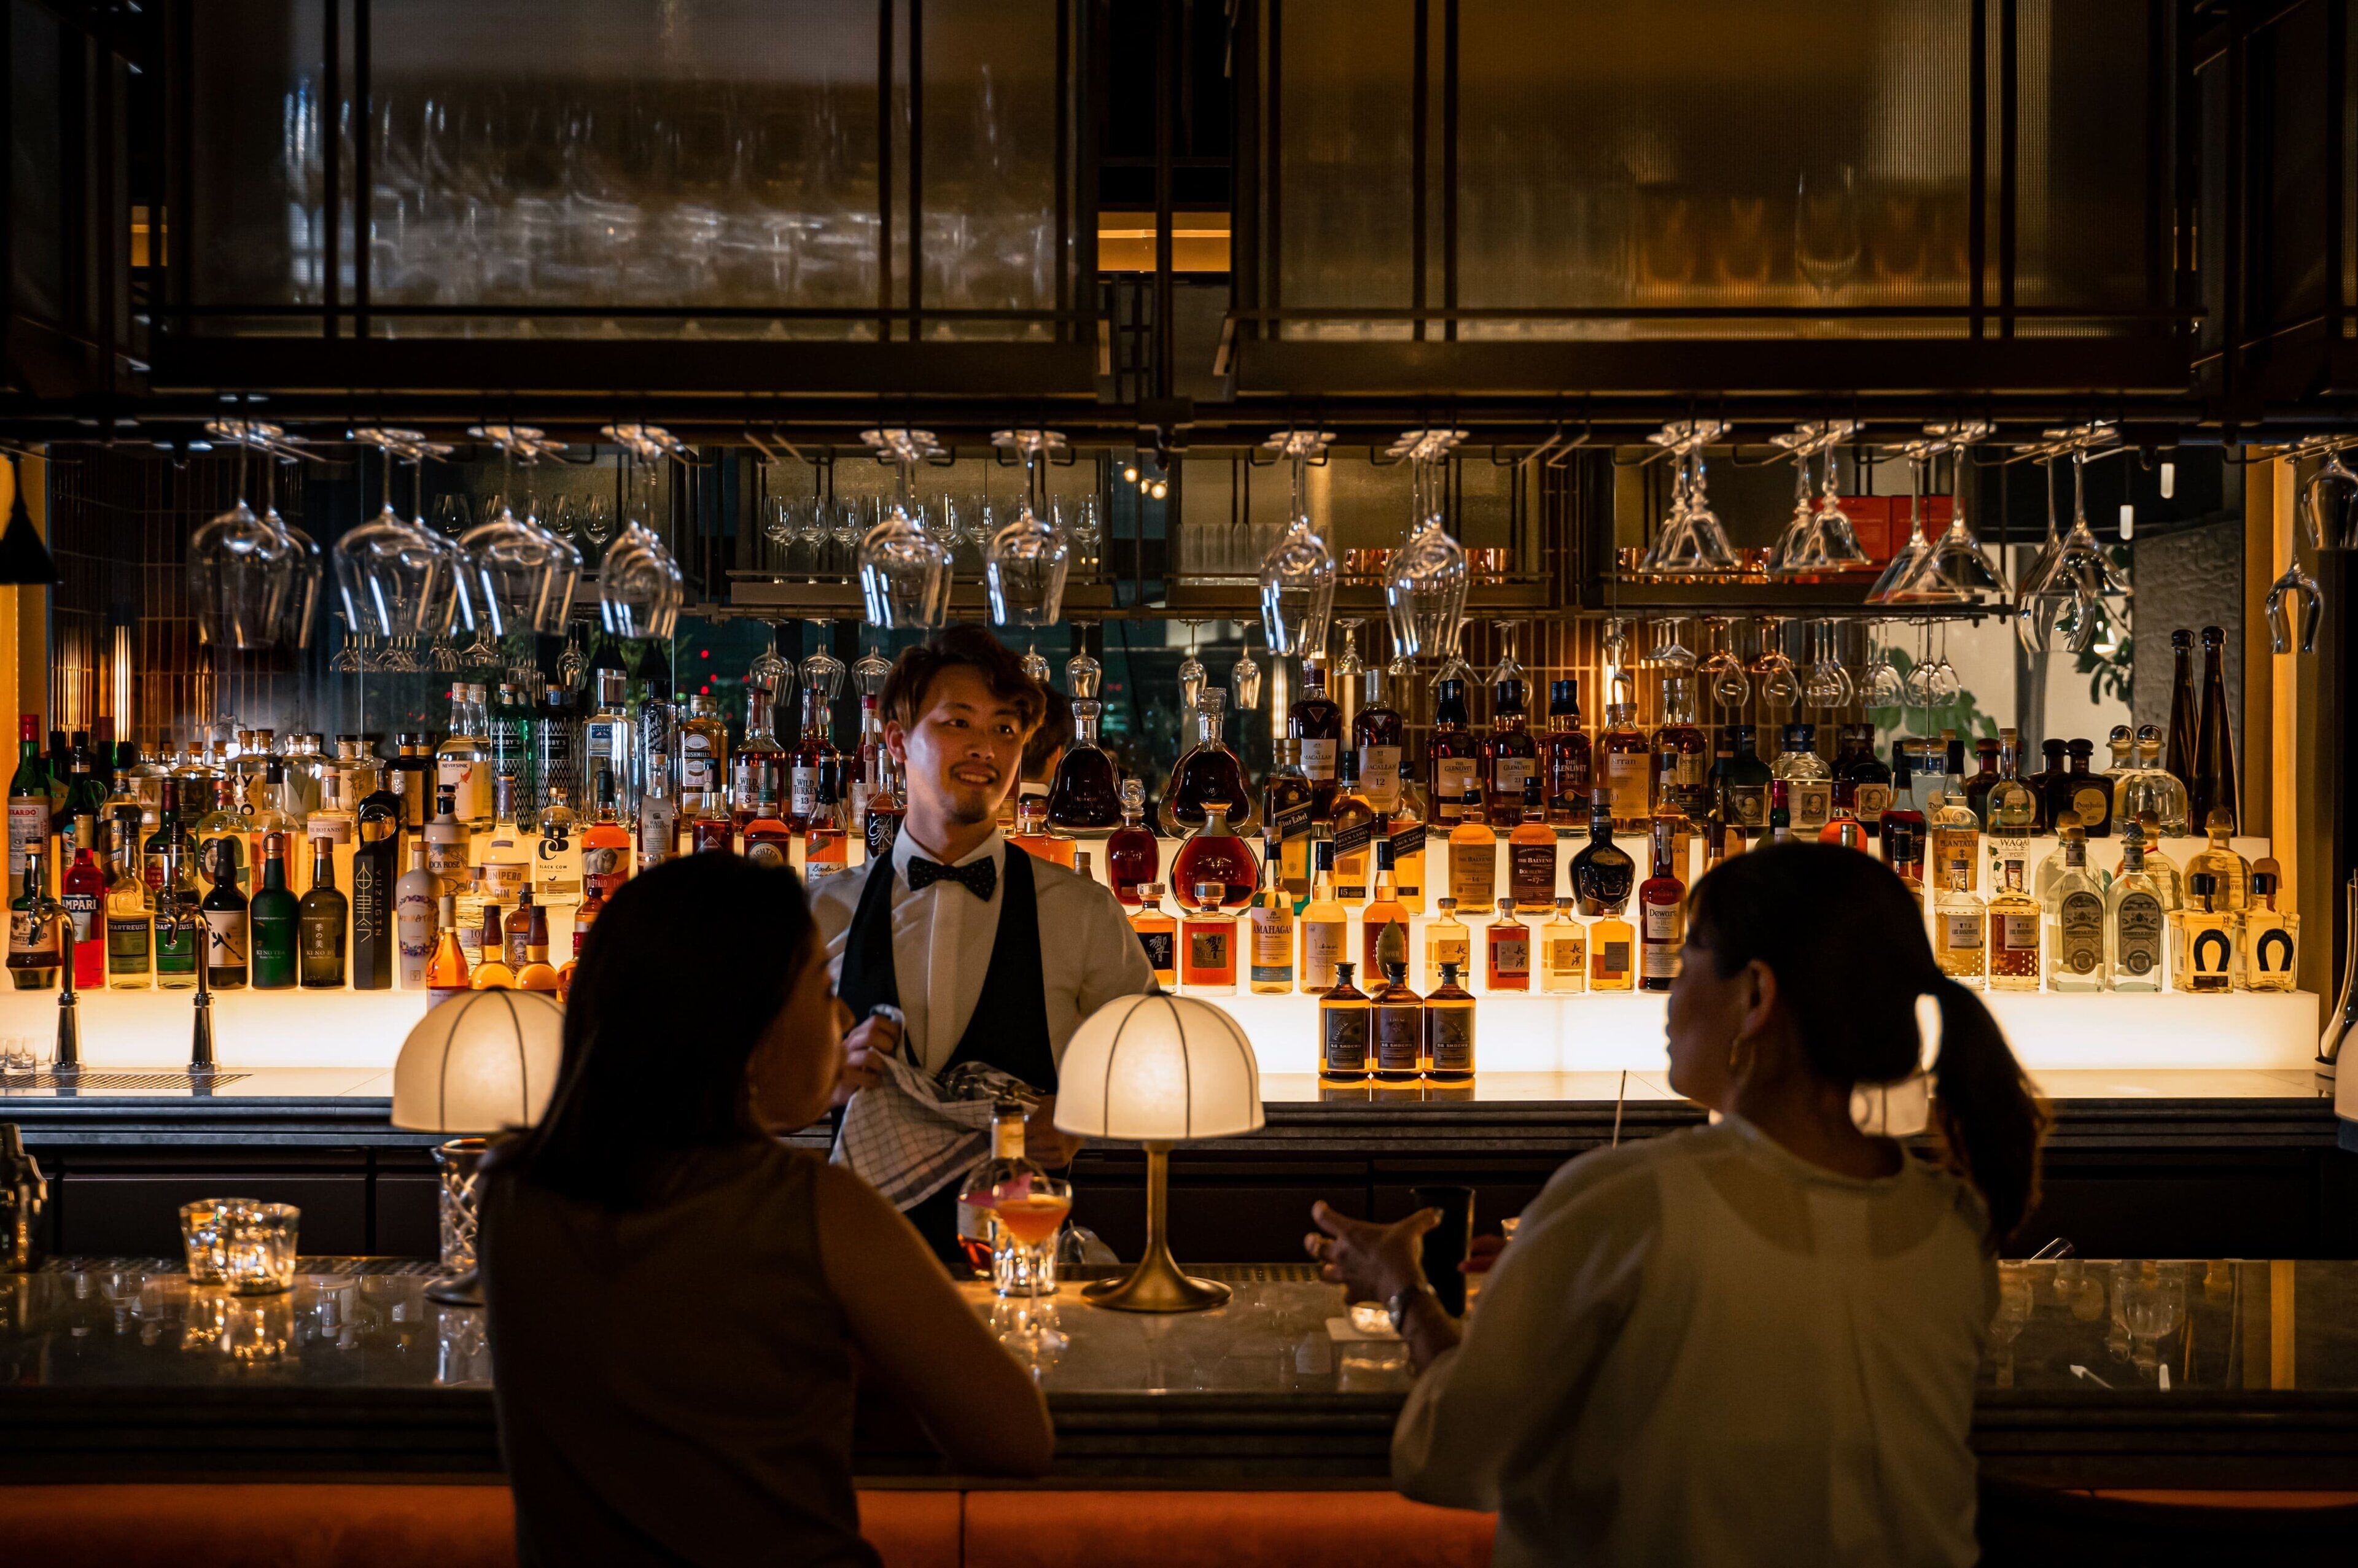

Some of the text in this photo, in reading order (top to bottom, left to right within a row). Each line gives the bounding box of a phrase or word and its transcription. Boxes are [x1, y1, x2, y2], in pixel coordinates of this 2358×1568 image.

[737, 783, 760, 793] TURKEY
[794, 785, 817, 795] TURKEY
[745, 794, 752, 803] 8
[1291, 813, 1308, 825] Label
[200, 839, 218, 862] PLYMOU
[486, 871, 522, 881] JUNIPERO
[494, 889, 510, 898] GIN
[62, 899, 96, 910] AMPARI
[315, 923, 324, 949] 季の美
[471, 930, 480, 938] 10
